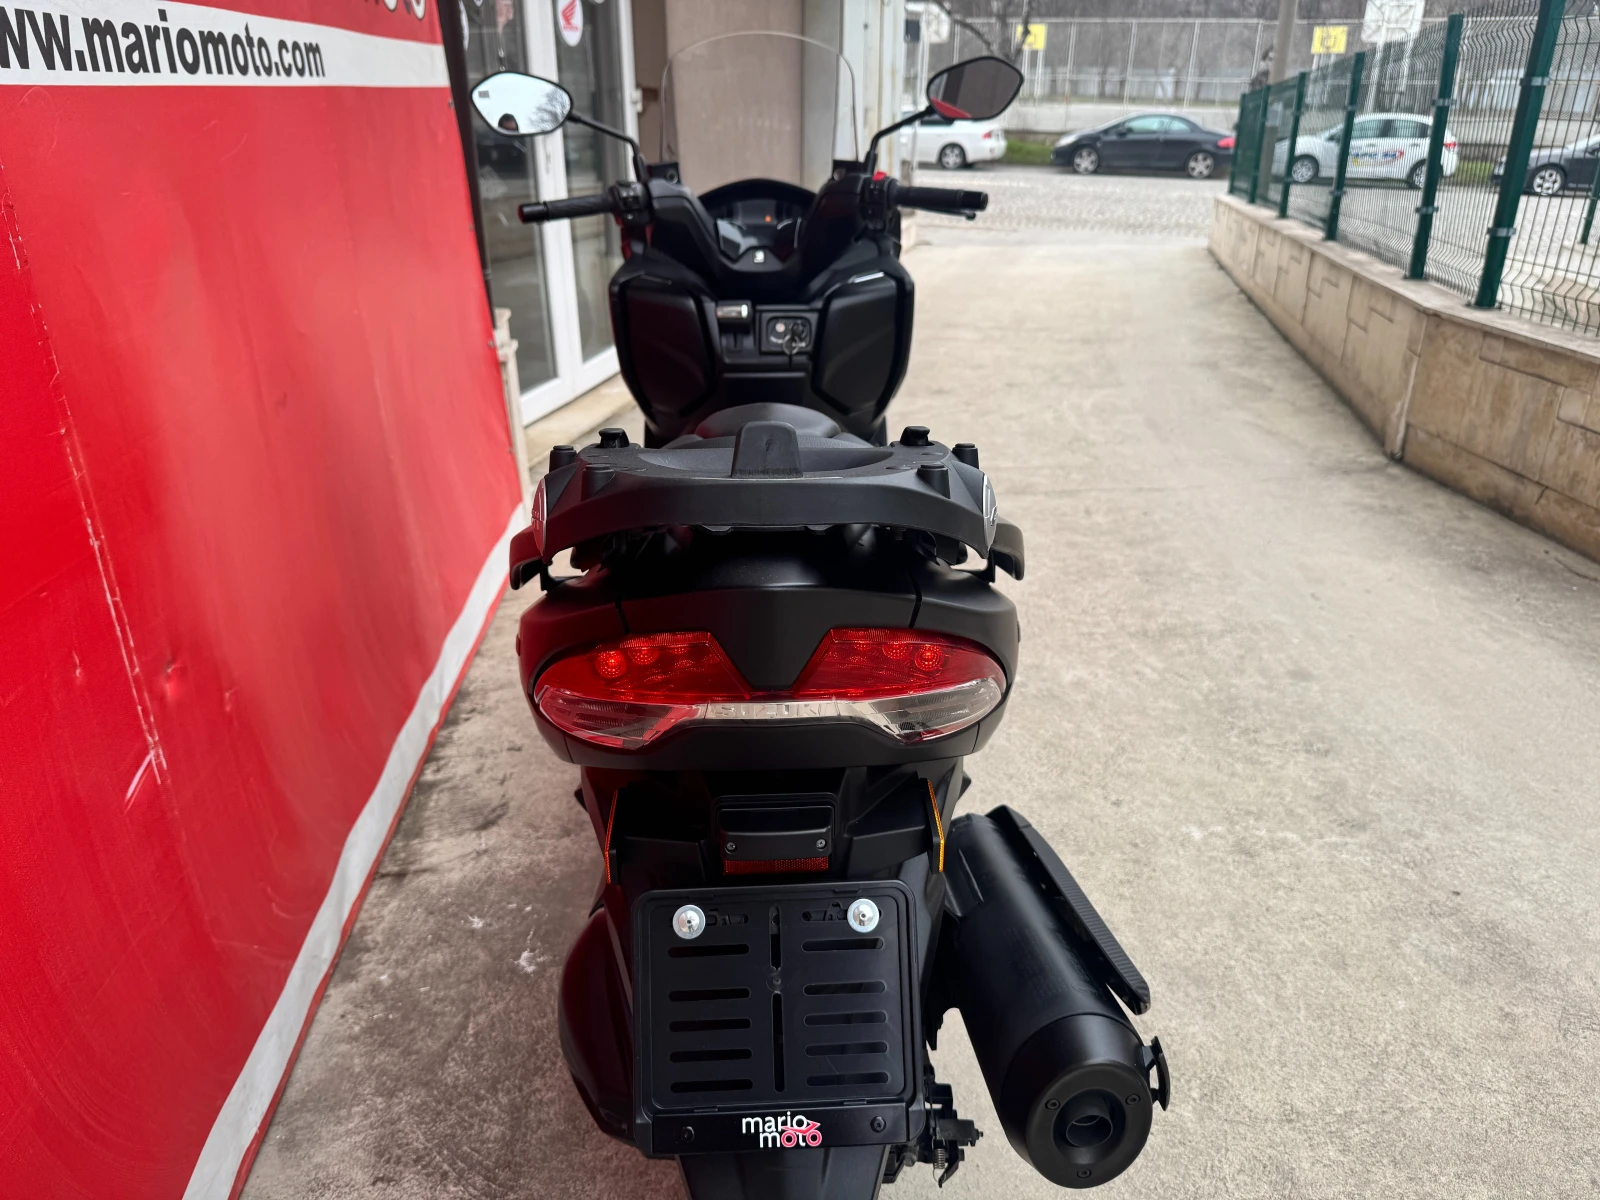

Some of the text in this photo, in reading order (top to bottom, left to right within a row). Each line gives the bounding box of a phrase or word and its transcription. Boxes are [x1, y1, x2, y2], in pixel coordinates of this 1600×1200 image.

[713, 702, 827, 718] SUZUKI
[742, 1111, 808, 1133] mario
[760, 1130, 822, 1148] moto
